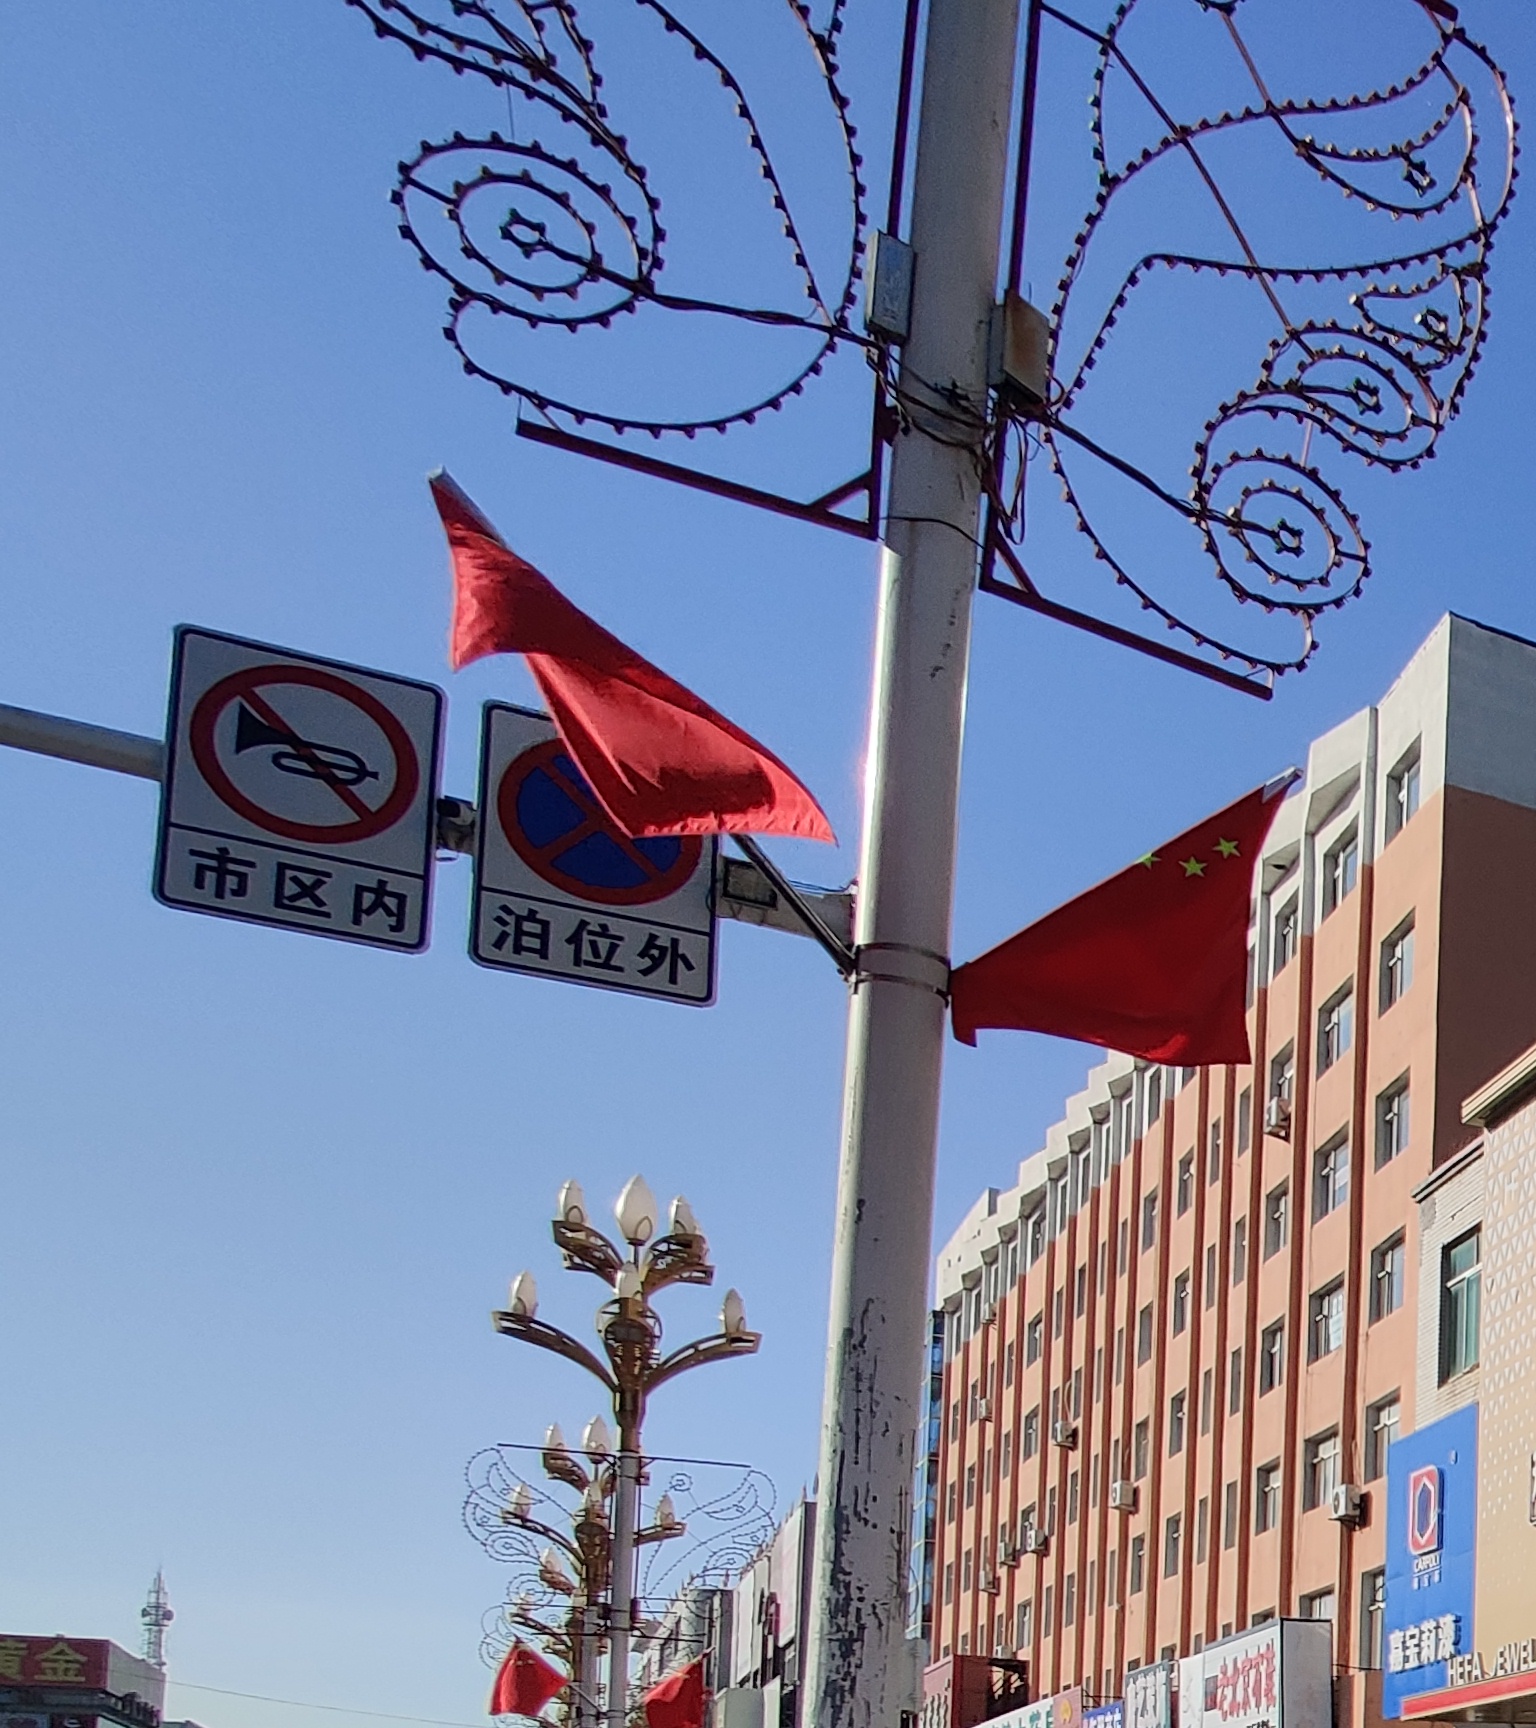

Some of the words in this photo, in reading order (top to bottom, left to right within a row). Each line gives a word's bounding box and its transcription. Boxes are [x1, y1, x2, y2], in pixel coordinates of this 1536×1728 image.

[190, 847, 408, 933] 市区内
[492, 903, 695, 985] 泊位外
[1447, 1651, 1484, 1688] HEFA
